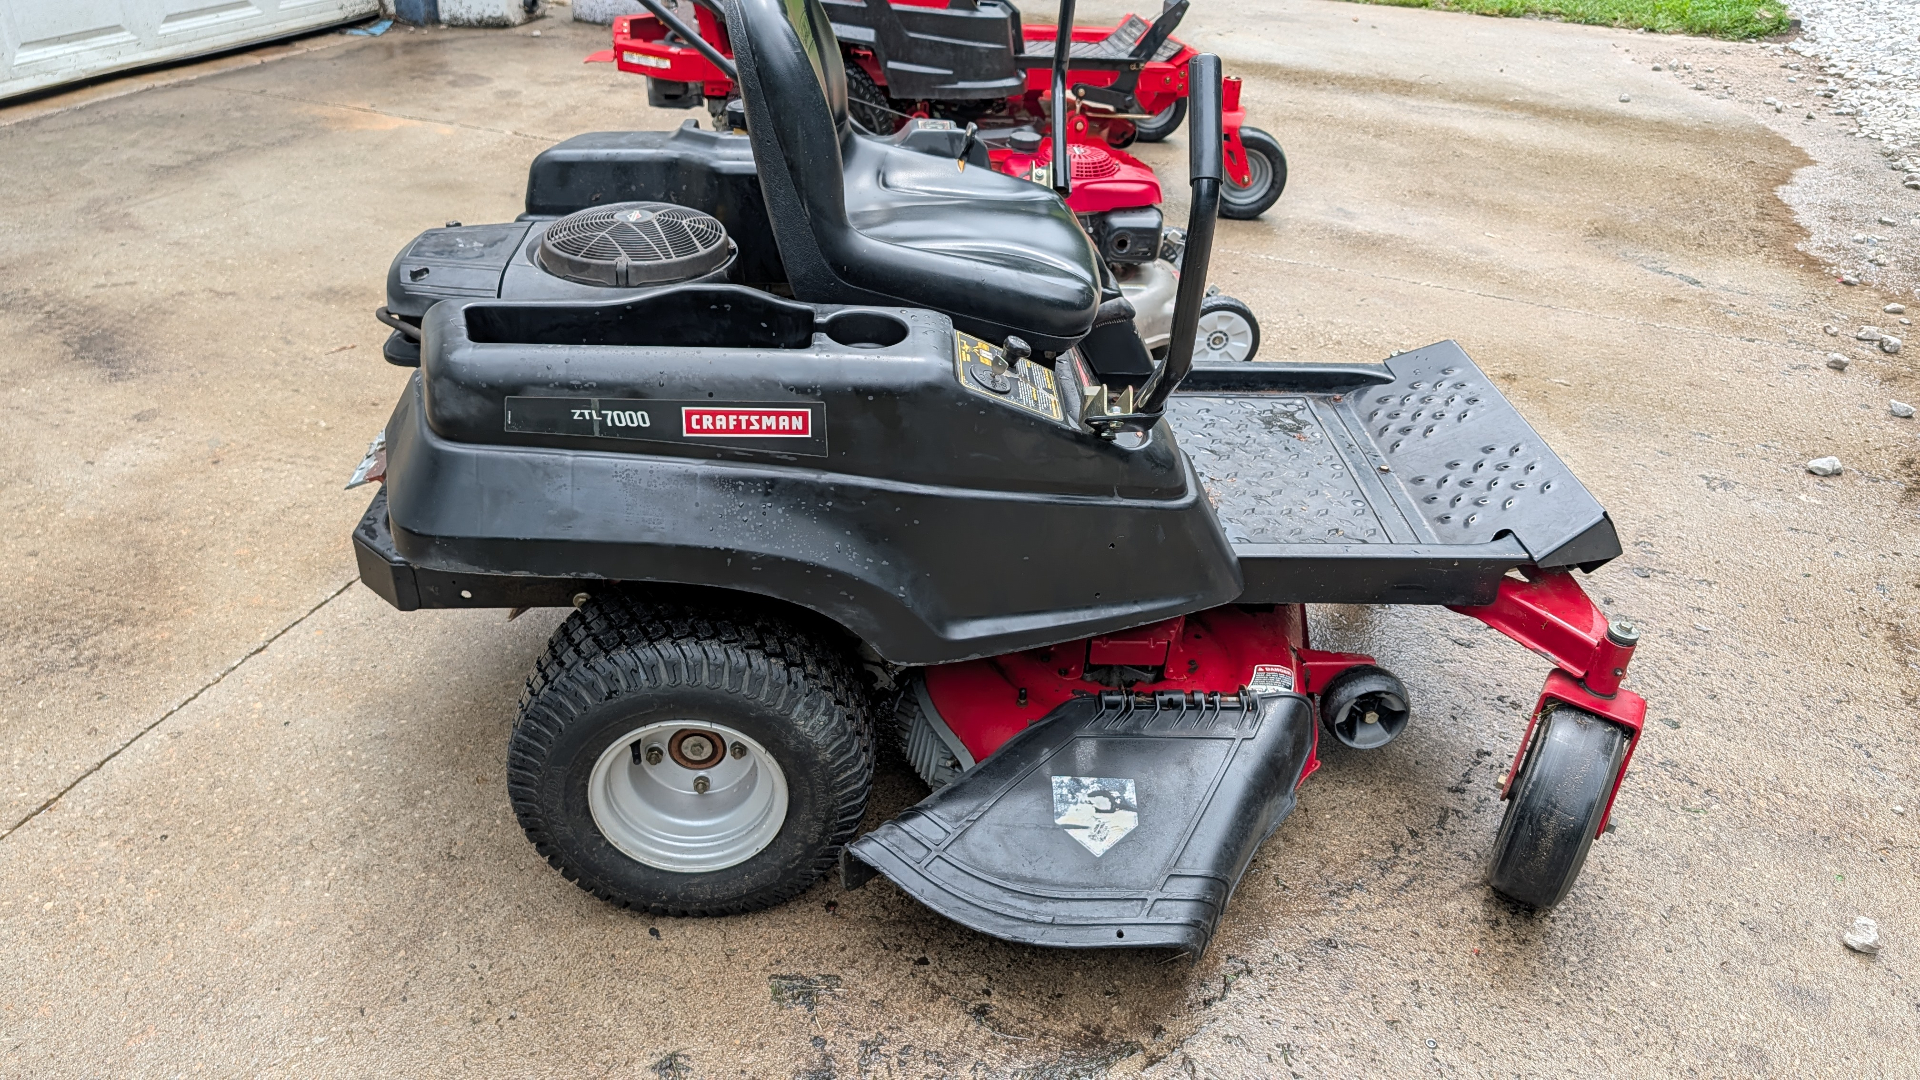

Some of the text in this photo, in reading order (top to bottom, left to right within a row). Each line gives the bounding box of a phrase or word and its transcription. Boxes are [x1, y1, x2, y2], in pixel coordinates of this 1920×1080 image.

[570, 409, 651, 427] ZTL 7000
[691, 414, 803, 431] CRAFTSMAN
[1264, 666, 1292, 676] DANGER
